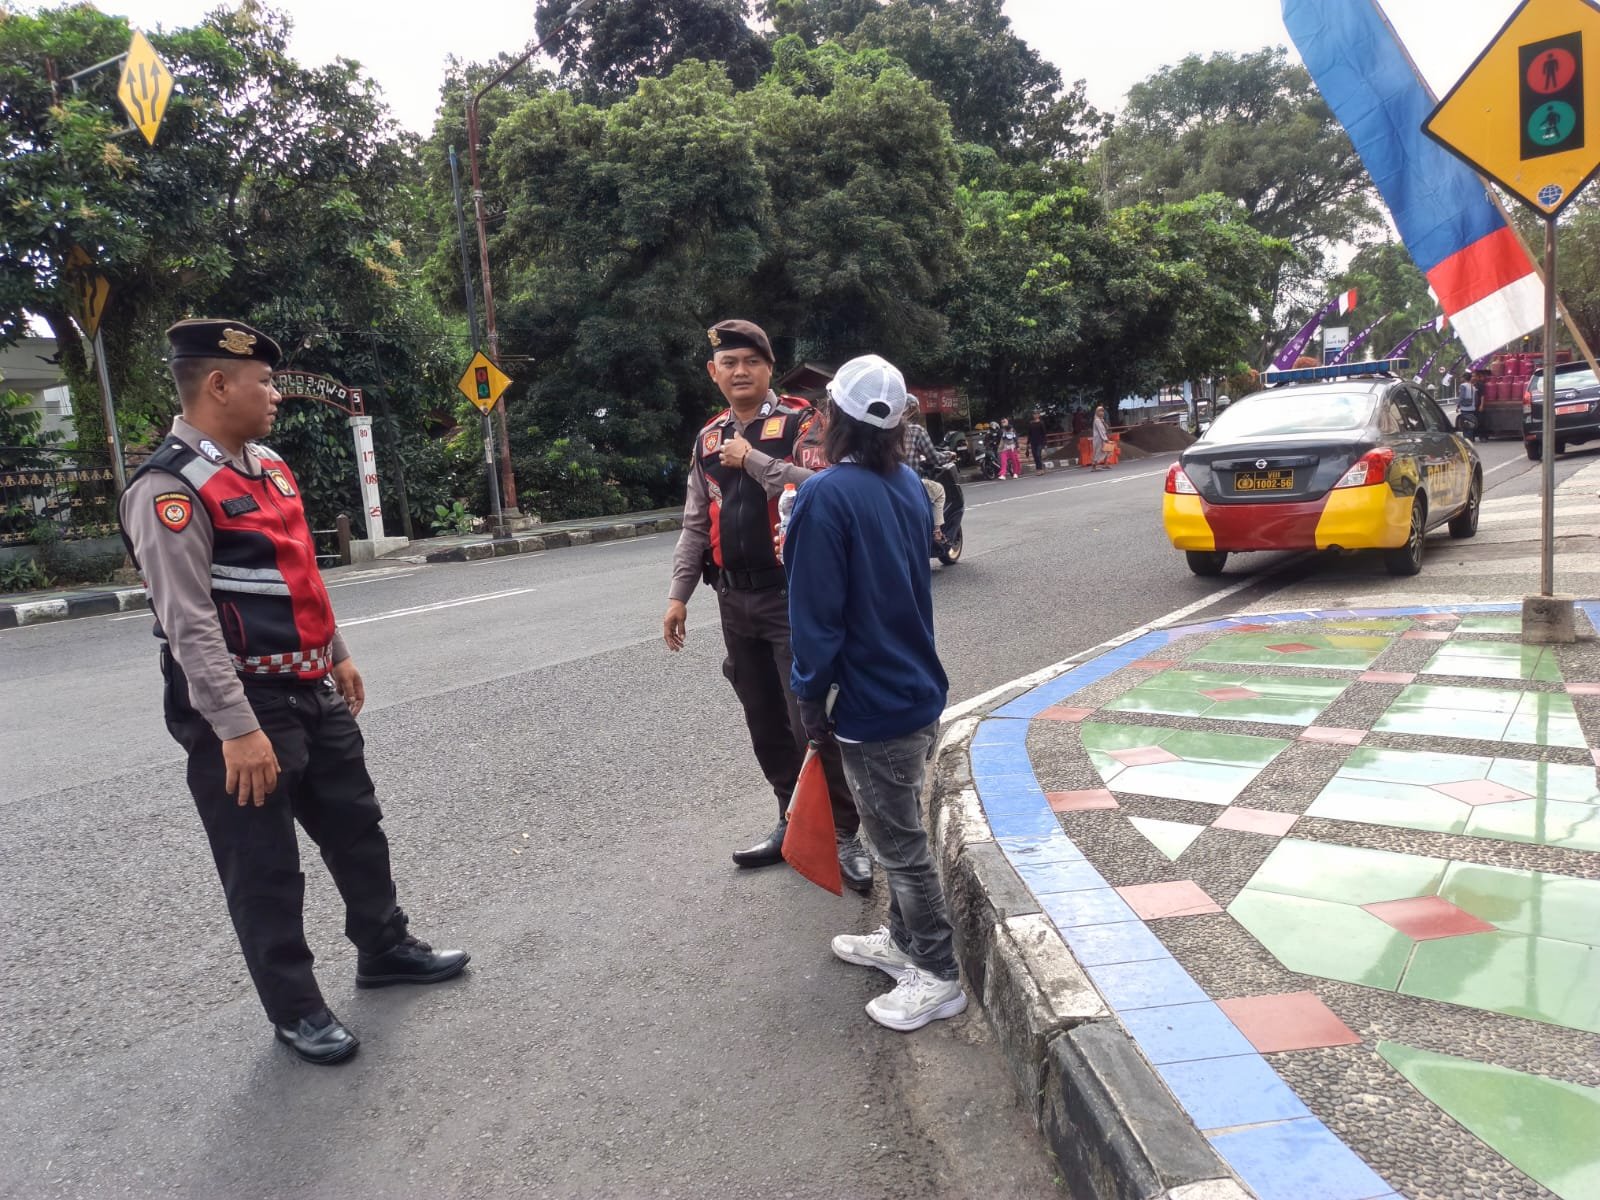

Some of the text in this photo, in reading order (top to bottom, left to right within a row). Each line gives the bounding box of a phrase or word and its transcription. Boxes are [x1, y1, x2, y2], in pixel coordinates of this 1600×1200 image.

[363, 451, 374, 462] 17
[365, 474, 380, 485] 08
[1256, 479, 1292, 489] 1002-56
